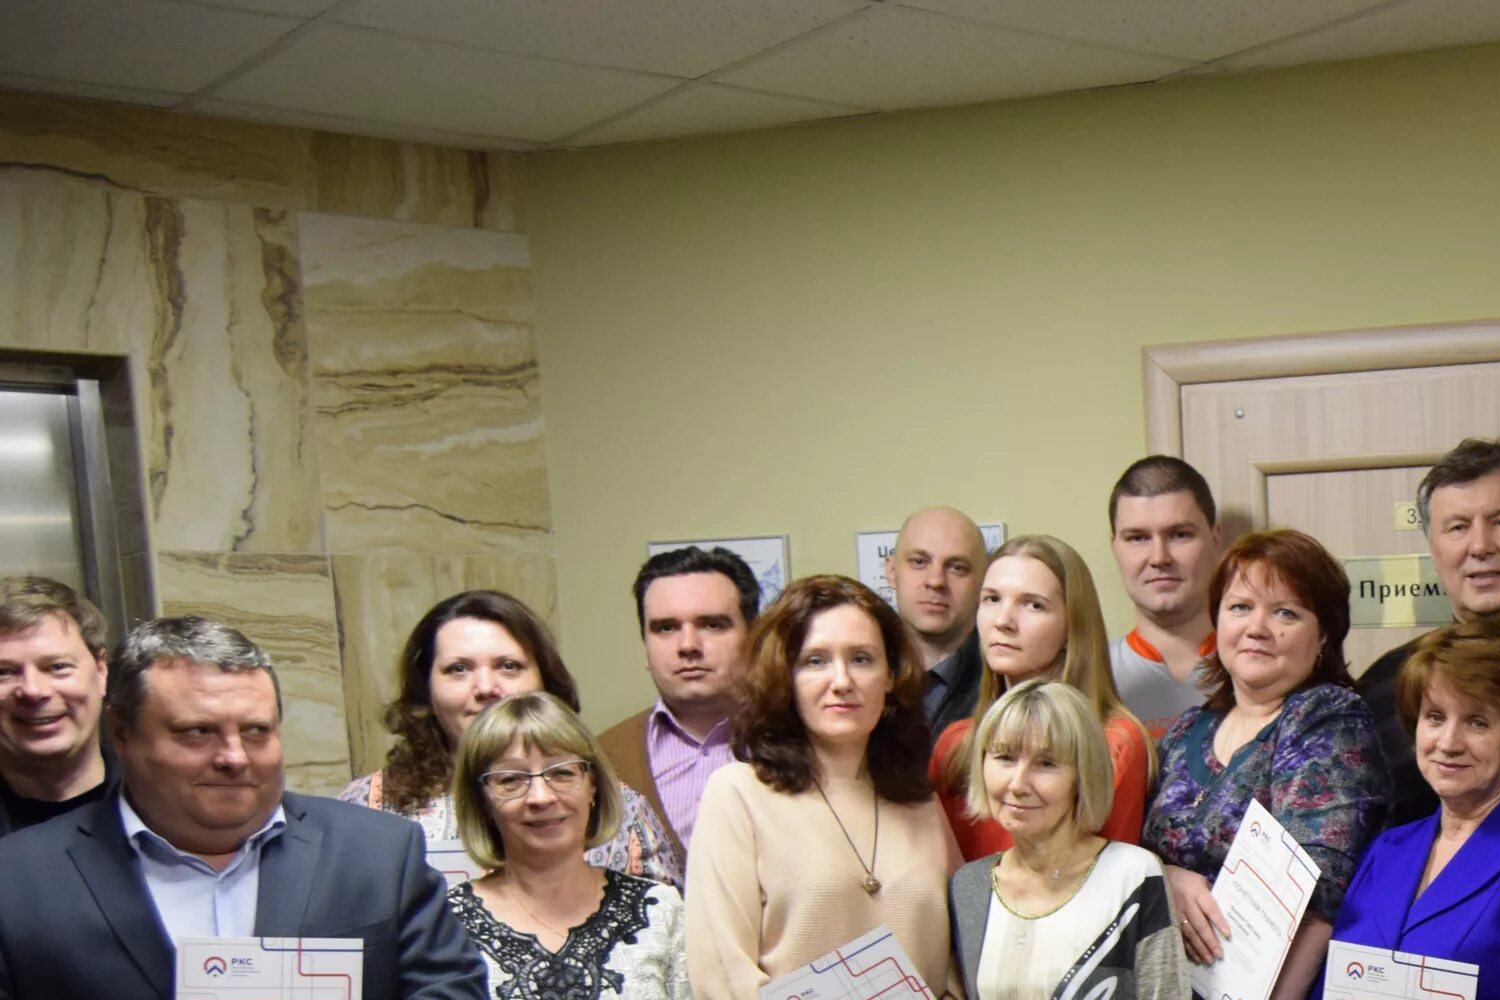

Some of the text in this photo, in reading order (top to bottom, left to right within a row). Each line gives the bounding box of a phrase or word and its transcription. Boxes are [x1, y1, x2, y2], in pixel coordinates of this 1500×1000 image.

[1360, 579, 1447, 603] Прием
[231, 957, 253, 966] РКС
[1367, 965, 1385, 974] РКС
